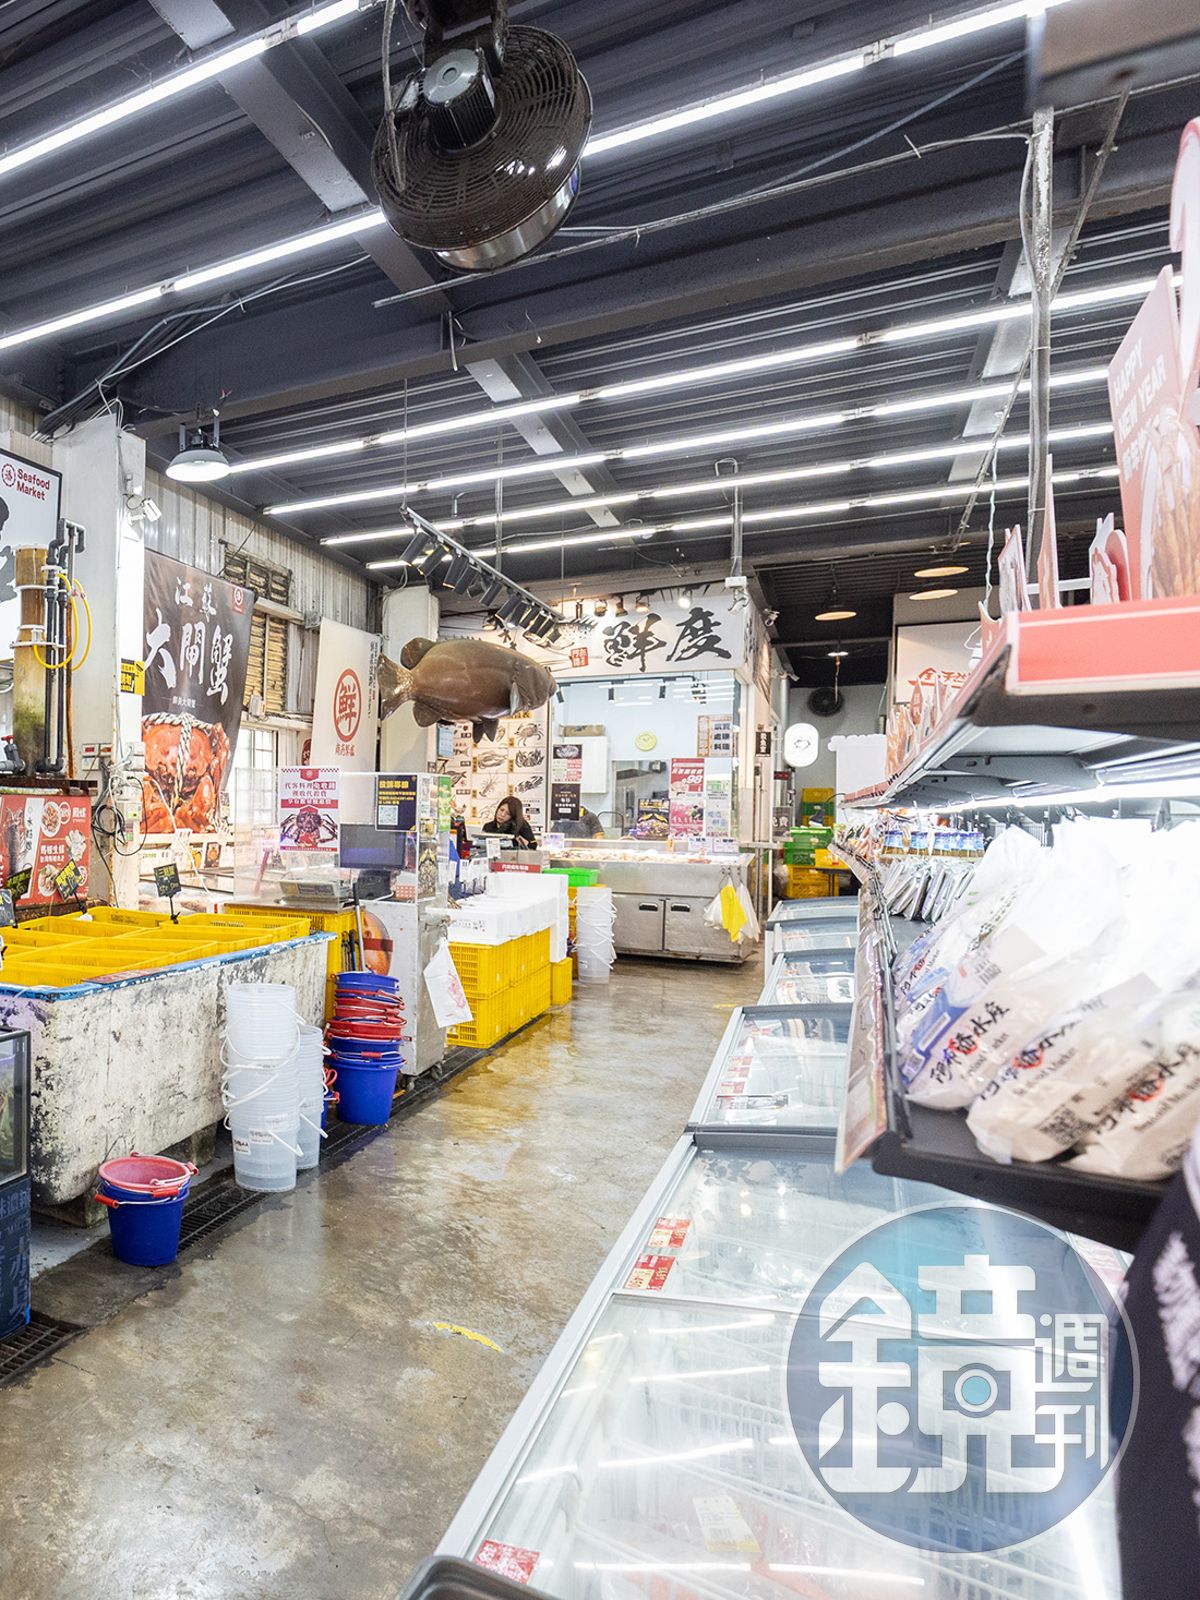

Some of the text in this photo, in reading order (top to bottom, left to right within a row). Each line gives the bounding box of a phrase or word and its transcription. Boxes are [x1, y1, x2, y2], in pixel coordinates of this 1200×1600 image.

[1113, 338, 1143, 406] HAPPY
[1118, 394, 1139, 444] NEW
[1137, 354, 1167, 412] YEAR
[16, 481, 46, 500] Market
[17, 468, 50, 490] Seafood
[175, 576, 217, 623] 江蘇
[144, 607, 234, 706] 大閘蟹
[601, 606, 732, 673] 鮮度
[336, 683, 358, 734] 鮮
